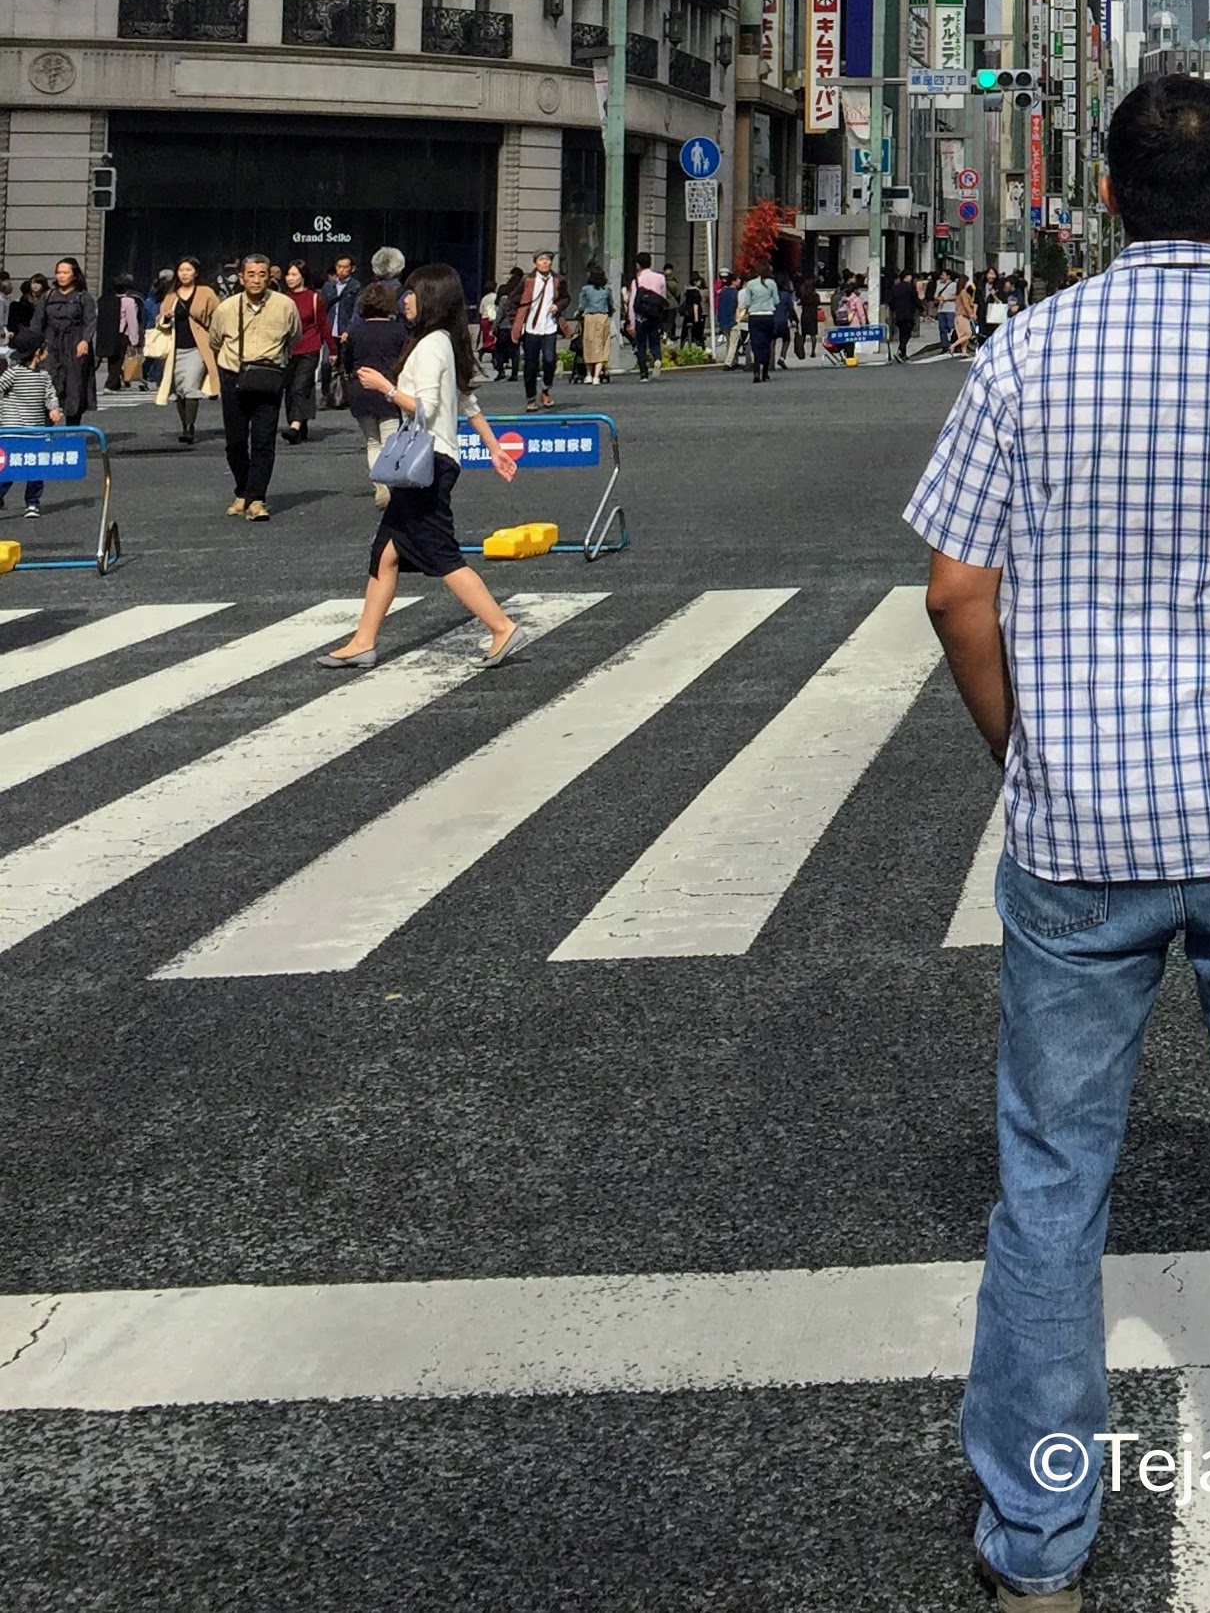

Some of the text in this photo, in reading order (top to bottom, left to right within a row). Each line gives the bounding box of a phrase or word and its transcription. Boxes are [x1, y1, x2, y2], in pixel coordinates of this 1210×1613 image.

[942, 14, 955, 69] ナルニア
[815, 17, 836, 122] キムラヤパン
[911, 75, 967, 86] 銀座四丁目
[314, 215, 332, 232] GS
[292, 232, 352, 243] Grand Seiko
[528, 438, 593, 453] 築地警察署
[9, 450, 79, 467] 築地警察署
